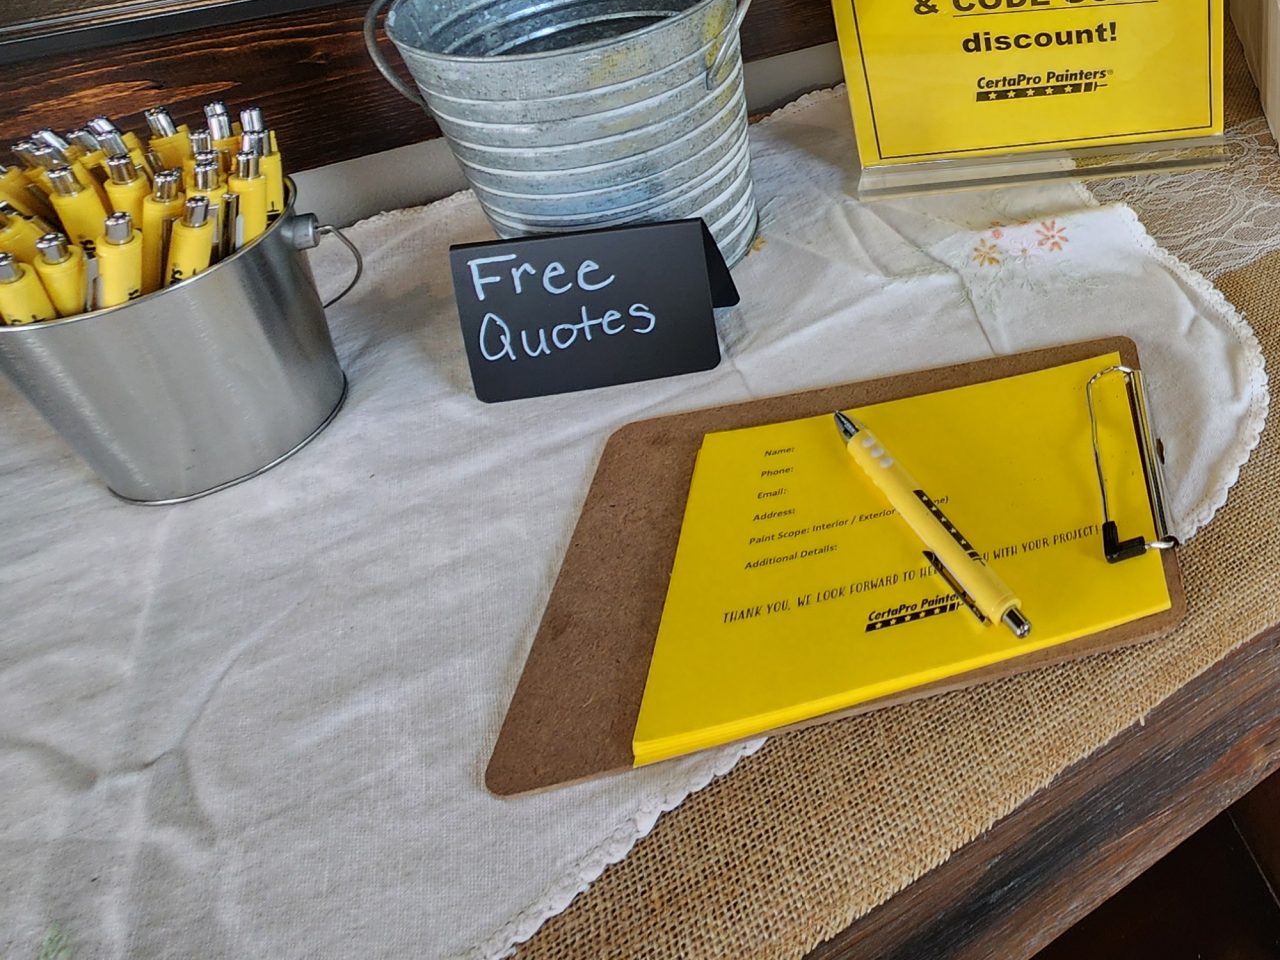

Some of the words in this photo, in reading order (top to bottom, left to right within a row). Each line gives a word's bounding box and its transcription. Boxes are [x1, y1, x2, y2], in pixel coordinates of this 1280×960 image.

[961, 22, 1117, 54] discount!
[977, 74, 1042, 91] CertaPro
[467, 253, 615, 301] Free
[479, 303, 656, 362] Quotes
[764, 447, 795, 457] Name:
[760, 467, 794, 478] Phone:
[757, 488, 787, 499] Email:
[749, 534, 775, 545] Paint
[777, 527, 810, 540] Scope:
[812, 518, 849, 532] Interior
[850, 515, 857, 526] /
[858, 508, 896, 523] Exterior
[752, 507, 796, 522] Address:
[744, 551, 798, 570] Additional
[800, 544, 838, 558] Details:
[723, 607, 763, 624] THANK
[766, 599, 791, 615] YOU,
[797, 595, 811, 608] WE
[817, 586, 846, 602] LOOK
[850, 573, 899, 594] FORWARD
[903, 569, 915, 583] TO
[993, 546, 1018, 561] WITH
[1022, 536, 1050, 553] YOUR
[1053, 524, 1099, 546] PROJECT!
[868, 598, 918, 622] CertaPro
